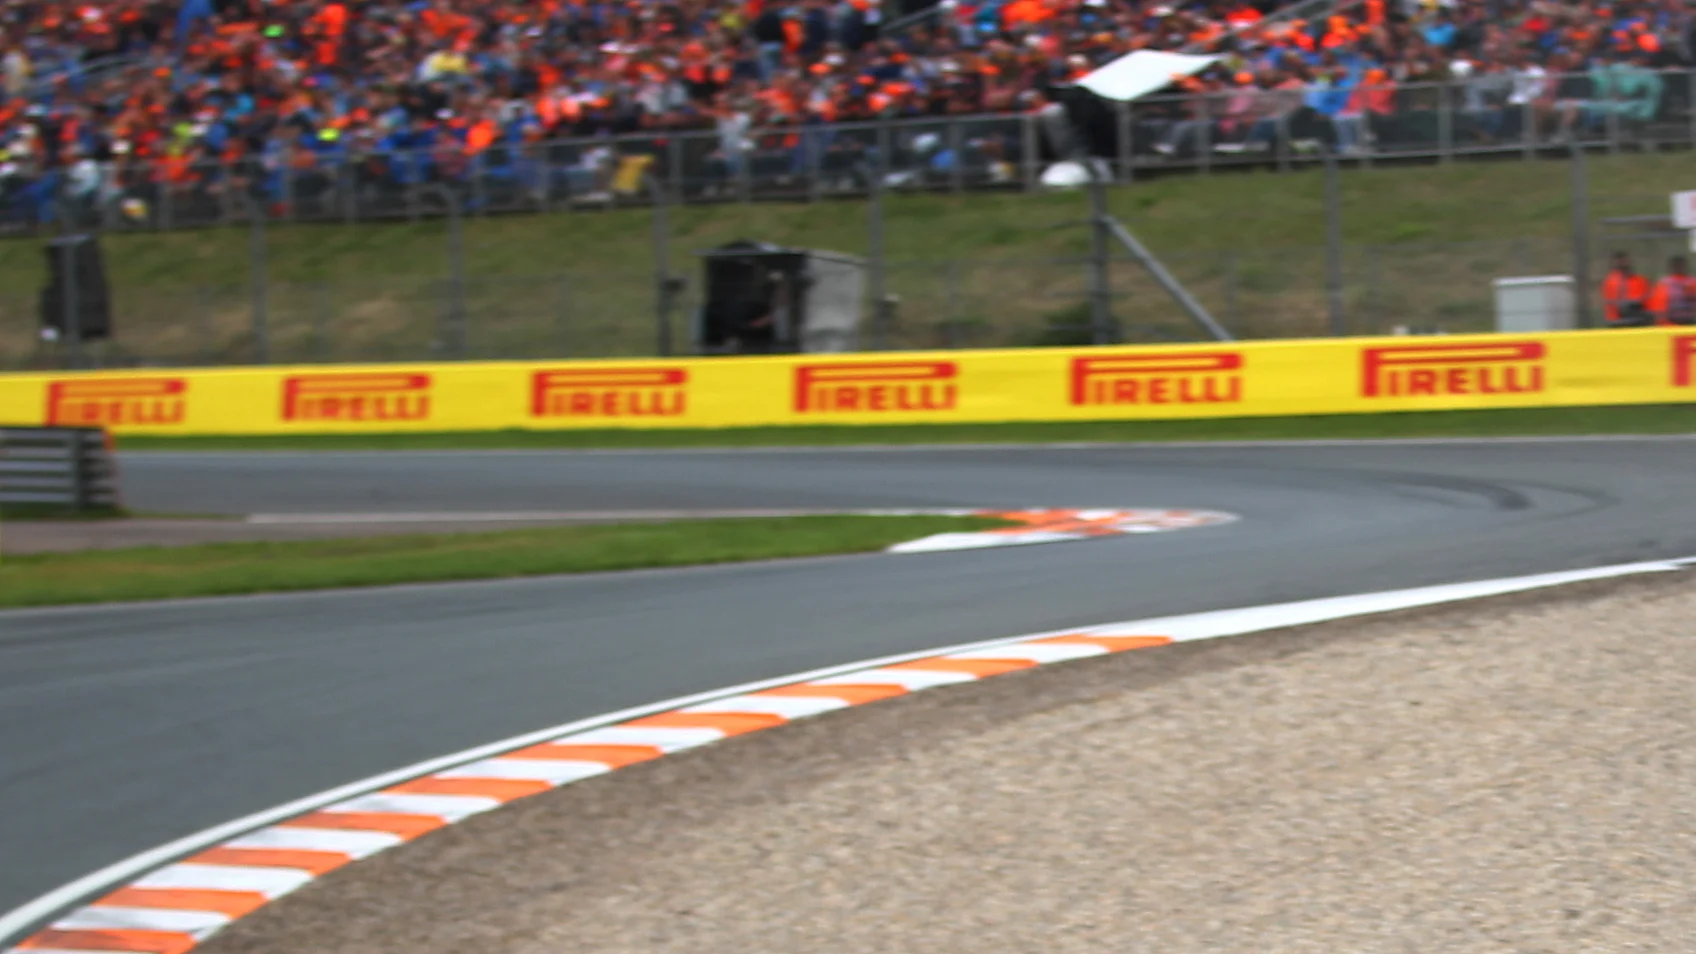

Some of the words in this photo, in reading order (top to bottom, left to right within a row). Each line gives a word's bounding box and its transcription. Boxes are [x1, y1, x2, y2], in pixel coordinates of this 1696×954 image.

[530, 367, 688, 417] PIRELLI
[793, 360, 958, 412] PIRELLI
[1069, 351, 1244, 405] PIRELLI
[1360, 340, 1547, 398] PIRELLI
[43, 377, 187, 426] PIRELLI
[281, 372, 432, 421] PIRELLI
